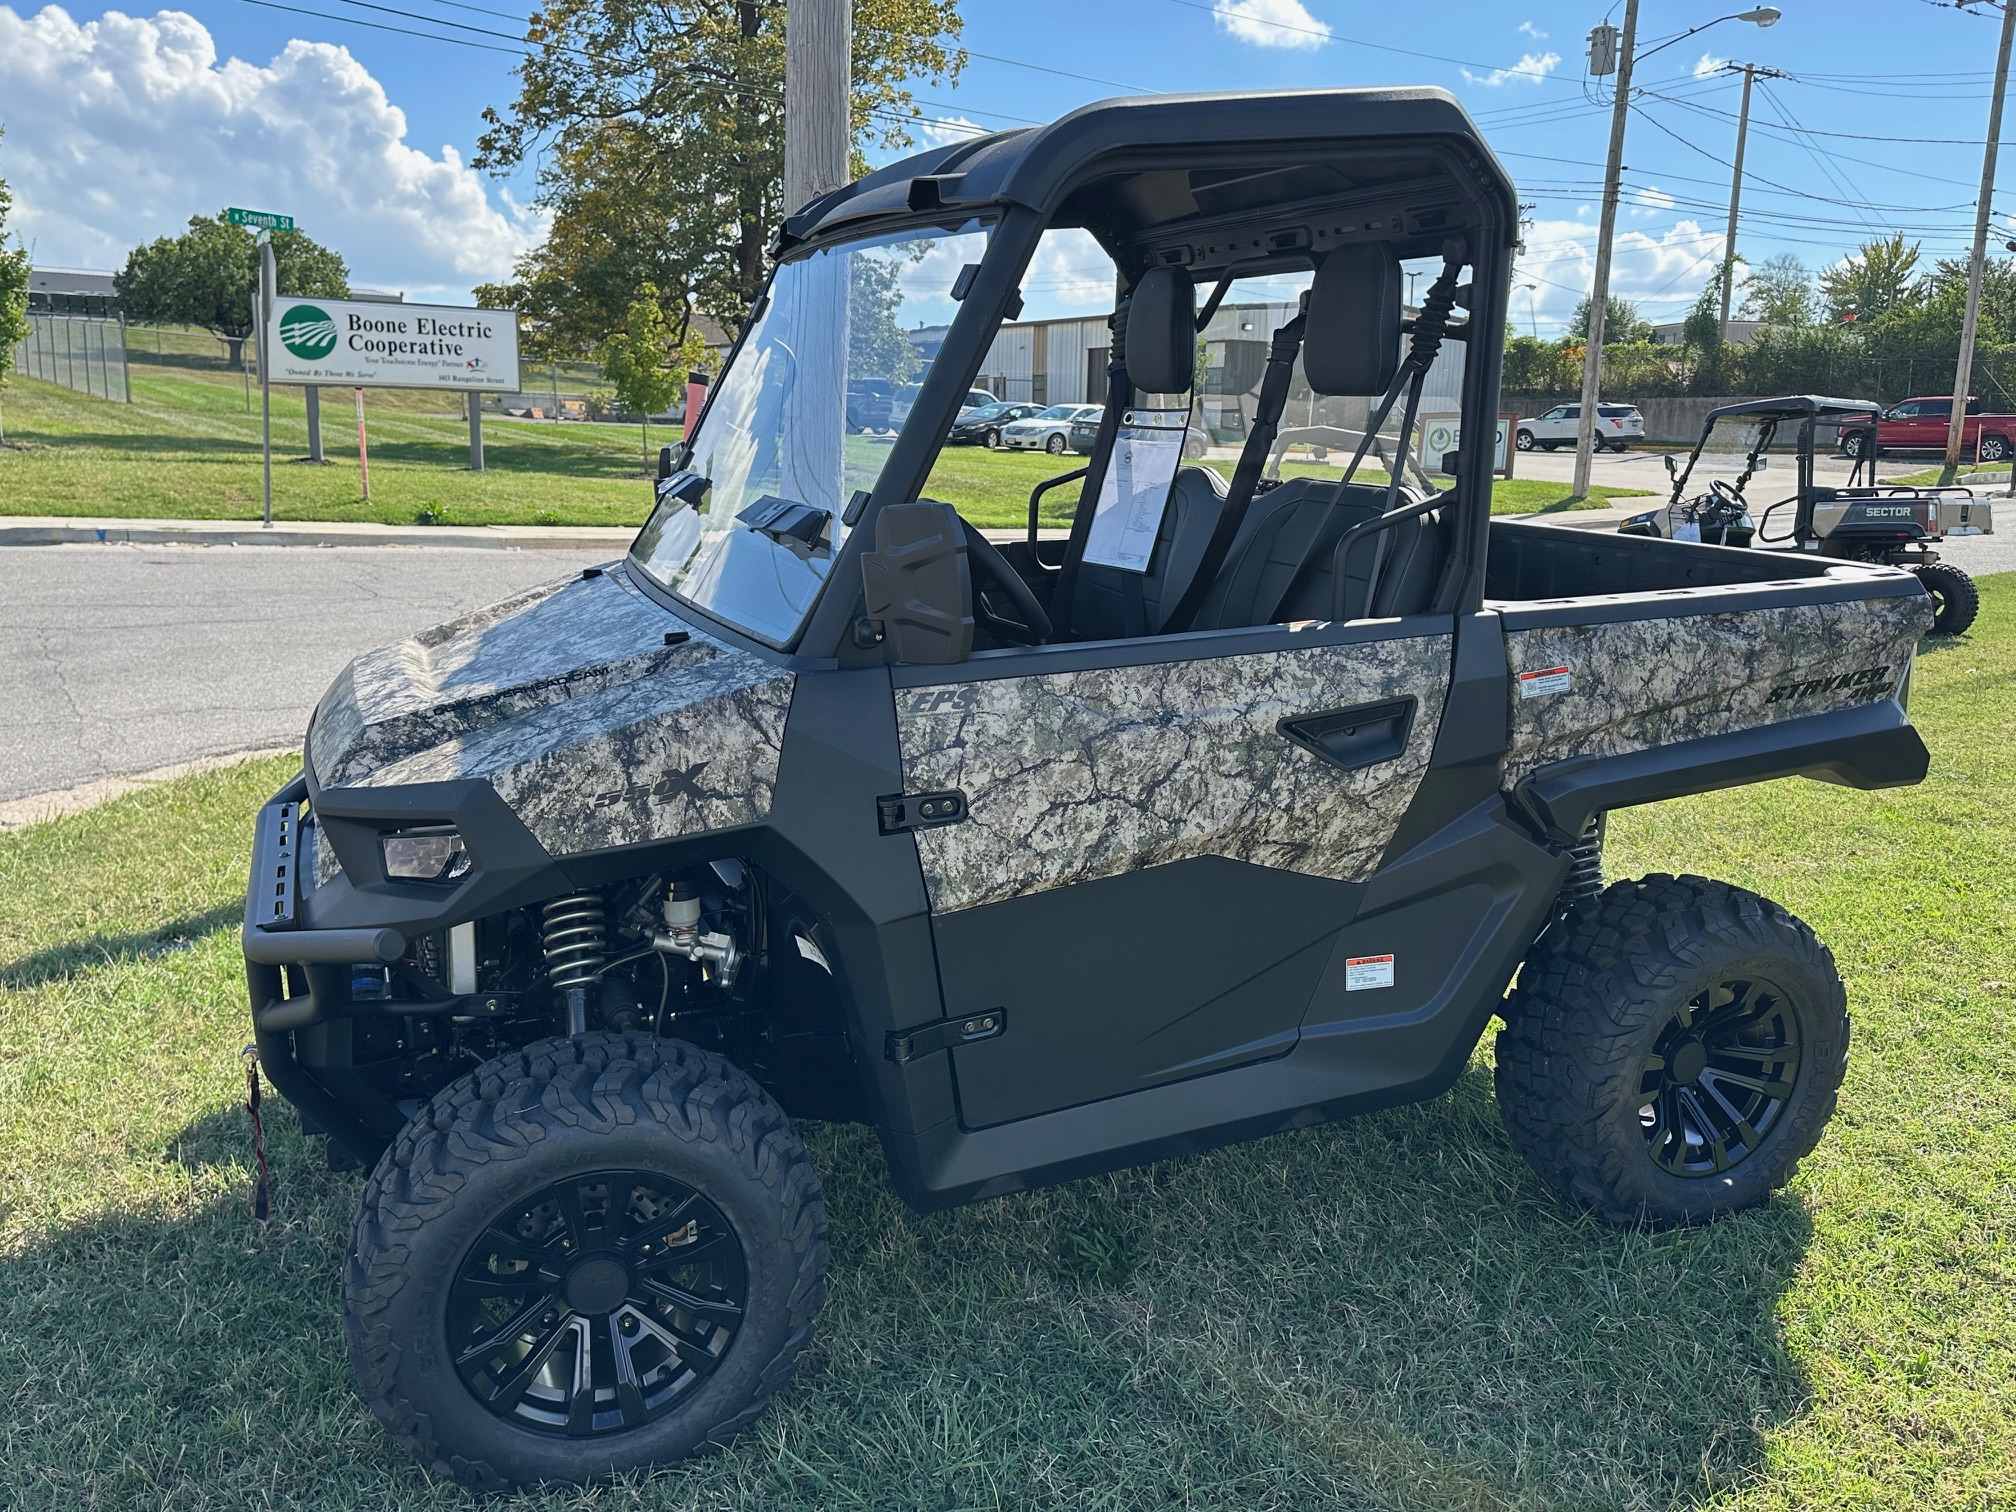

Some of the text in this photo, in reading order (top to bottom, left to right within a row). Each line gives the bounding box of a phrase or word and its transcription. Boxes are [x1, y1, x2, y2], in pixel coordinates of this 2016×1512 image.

[234, 210, 290, 229] N Seventh St
[347, 313, 492, 338] Boone Electric
[348, 333, 463, 356] Cooperative
[364, 356, 379, 364] Your
[381, 357, 416, 366] Touchstone
[453, 375, 484, 384] Rangeline
[1865, 507, 1911, 517] SECTOR
[480, 677, 569, 703] OVERHEAD
[1765, 666, 1890, 703] STRYKER
[908, 684, 979, 713] EPS
